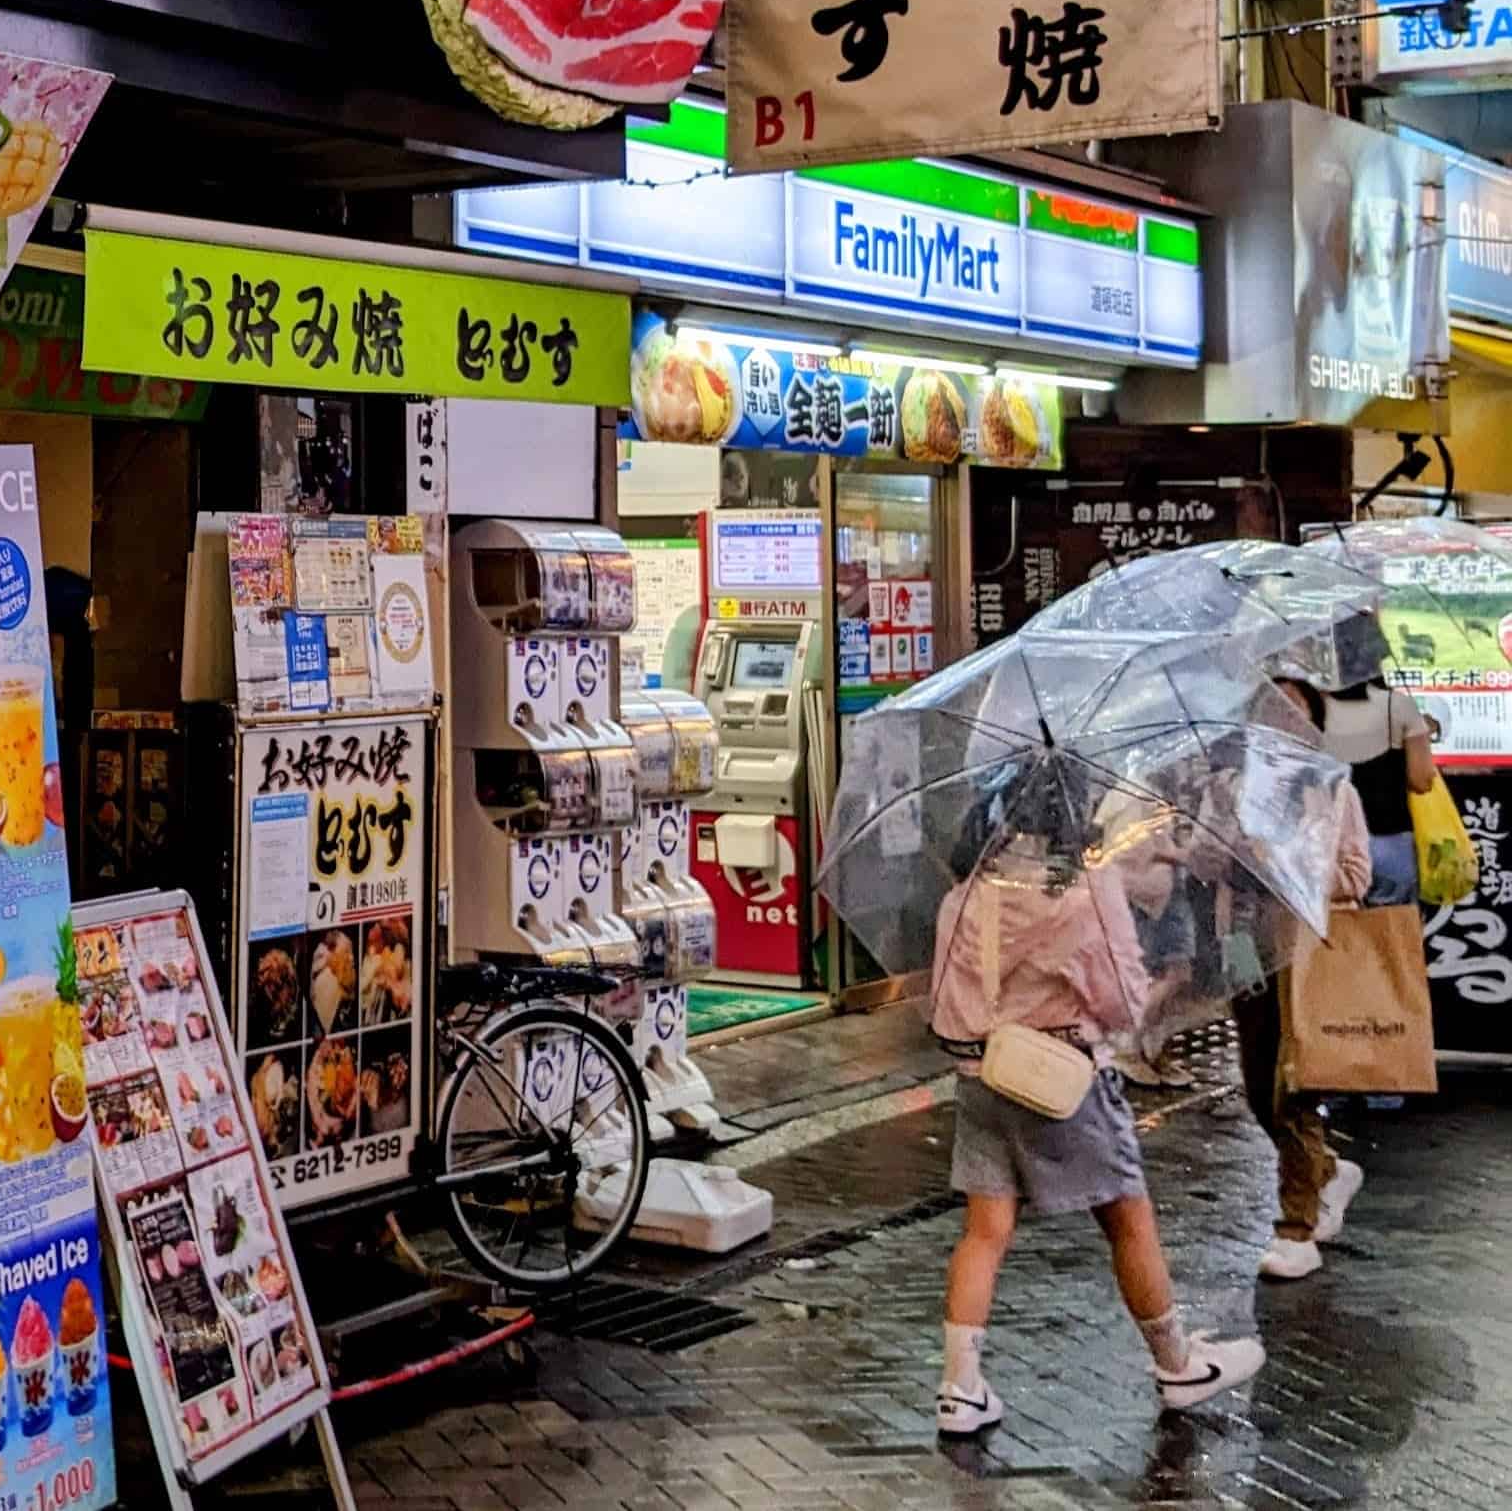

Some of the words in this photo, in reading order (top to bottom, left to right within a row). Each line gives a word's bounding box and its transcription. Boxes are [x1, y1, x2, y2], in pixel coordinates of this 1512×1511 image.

[754, 90, 817, 147] B1
[834, 200, 1001, 298] FamilyMart
[163, 267, 405, 379] お好み焼
[455, 305, 580, 387] とむす
[1309, 355, 1383, 396] SHIBATA
[407, 394, 439, 491] ばこ
[739, 600, 807, 618] 銀行ATM
[979, 581, 1007, 633] RIB
[257, 726, 412, 795] お好み焼
[315, 791, 412, 877] とむす
[746, 904, 799, 926] net
[292, 1133, 403, 1186] 6212-7399
[61, 1236, 90, 1265] Ice
